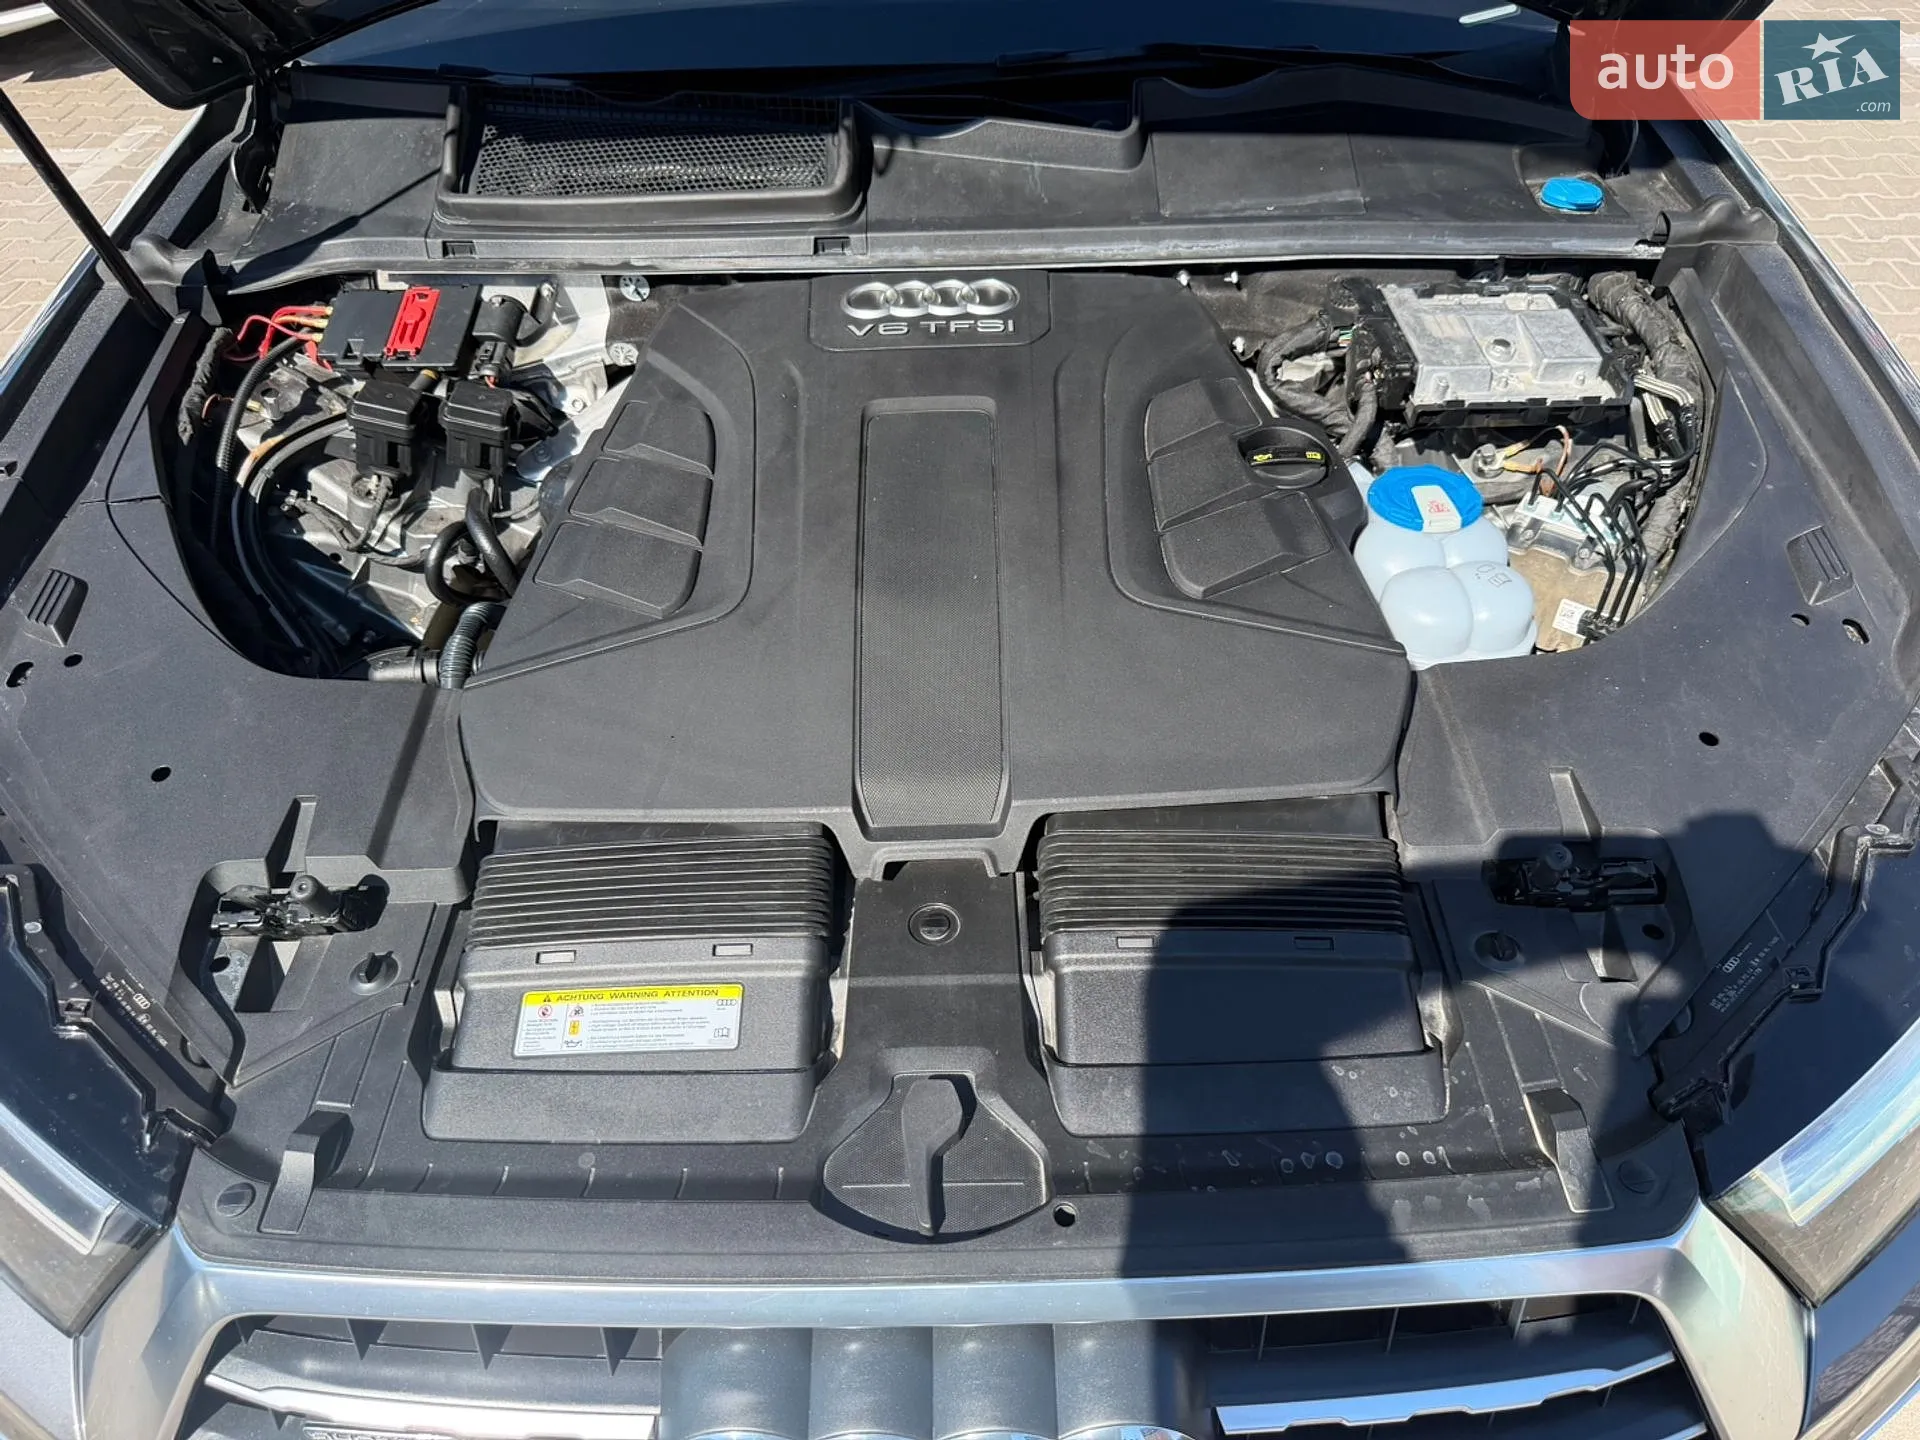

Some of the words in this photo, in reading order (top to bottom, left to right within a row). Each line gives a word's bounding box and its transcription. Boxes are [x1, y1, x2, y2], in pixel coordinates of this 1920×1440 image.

[847, 322, 909, 337] V6
[919, 319, 1016, 334] TFSI
[556, 993, 604, 1001] ACHTUNG
[609, 991, 658, 999] WARNING
[664, 989, 719, 998] ATTENTION
